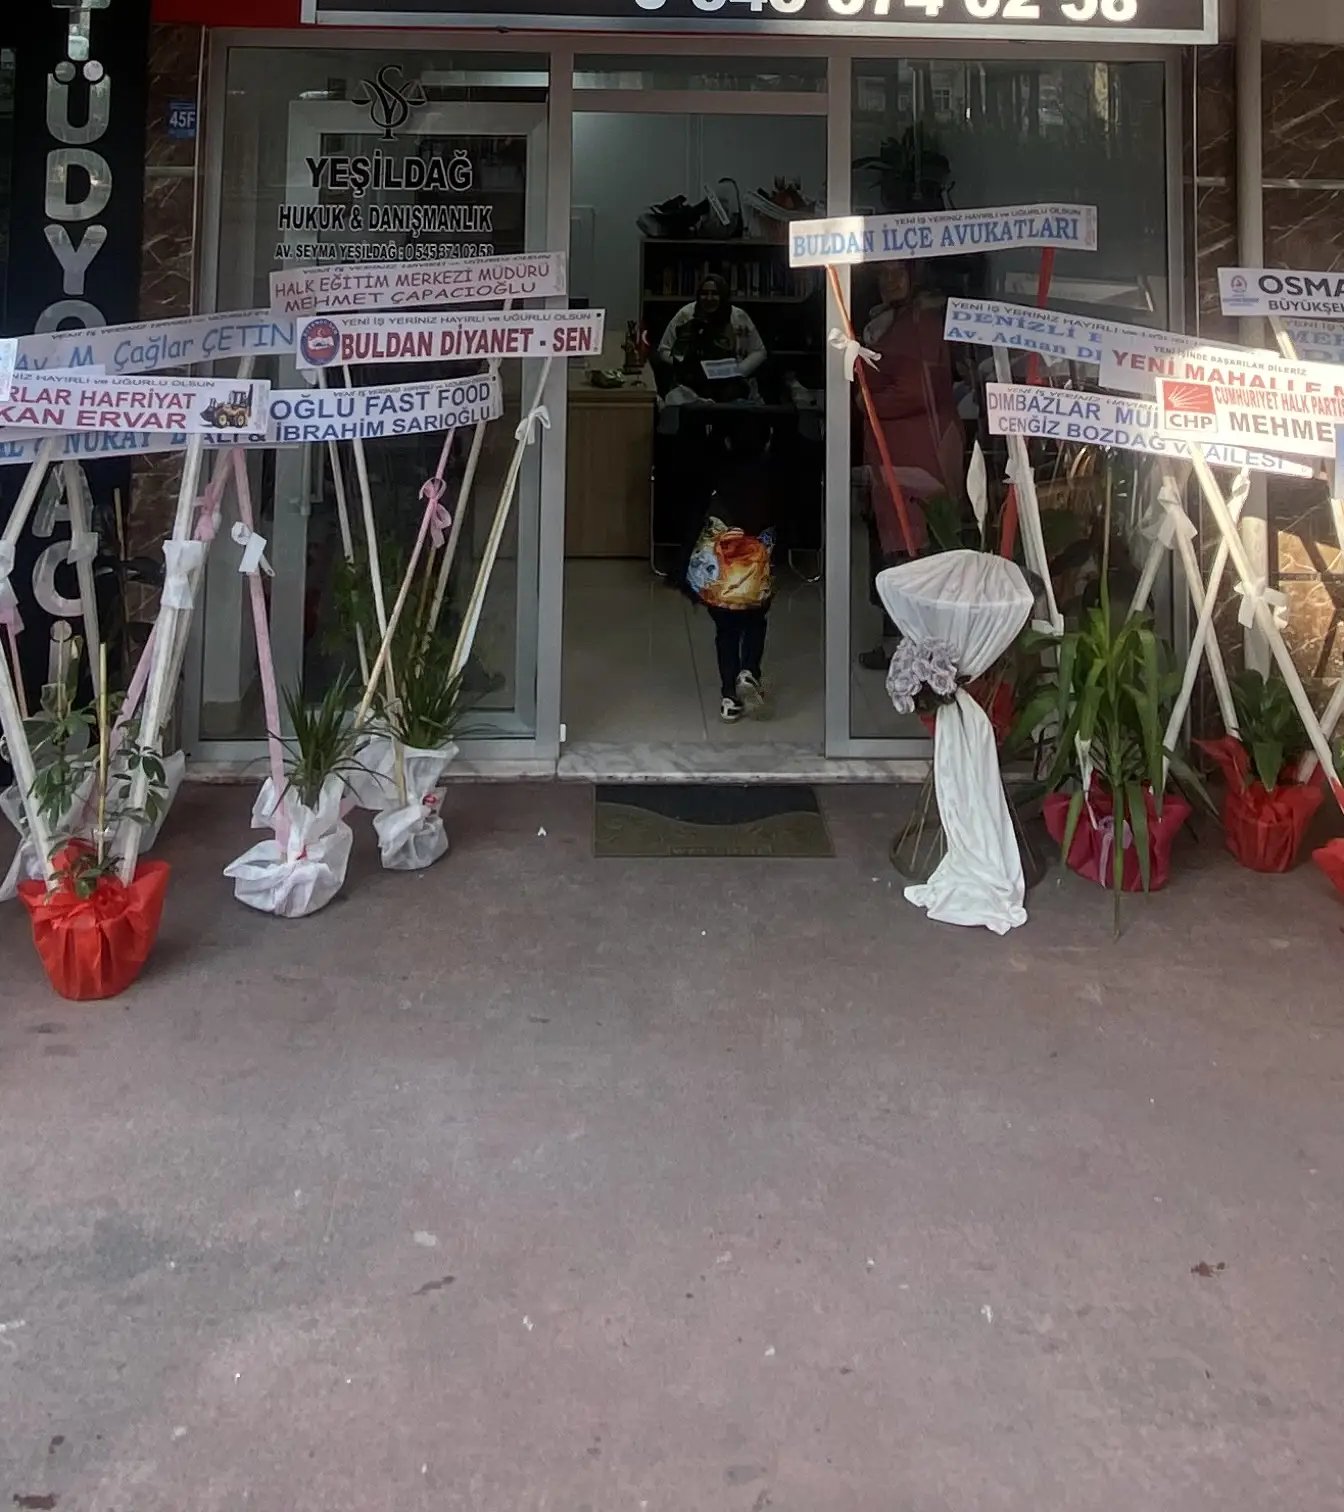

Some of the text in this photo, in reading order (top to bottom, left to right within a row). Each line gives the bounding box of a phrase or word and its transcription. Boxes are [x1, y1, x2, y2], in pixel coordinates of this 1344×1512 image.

[169, 111, 196, 128] 45F
[305, 149, 473, 197] YEŞİLDAĞ
[278, 205, 494, 238] HUKUK DANIŞMANLIK
[793, 216, 1079, 257] BULDAN İLÇE AVUKATLARI
[275, 262, 550, 299] HALK EĞİTİM MERKEZİ MÜDÜRÜ
[284, 291, 385, 314] MEHMET
[341, 323, 592, 361] BULDAN DİYANET SEN
[1112, 349, 1175, 376] YENİ
[79, 387, 197, 410] HAFRİYAT
[365, 383, 491, 417] FAST FOOD
[988, 392, 1101, 421] DIMBAZLAR
[1281, 395, 1310, 413] HALK
[76, 411, 187, 430] ERVAR
[276, 405, 491, 442] İBRAHİM SARIOĞLU
[1168, 413, 1213, 430] CHP
